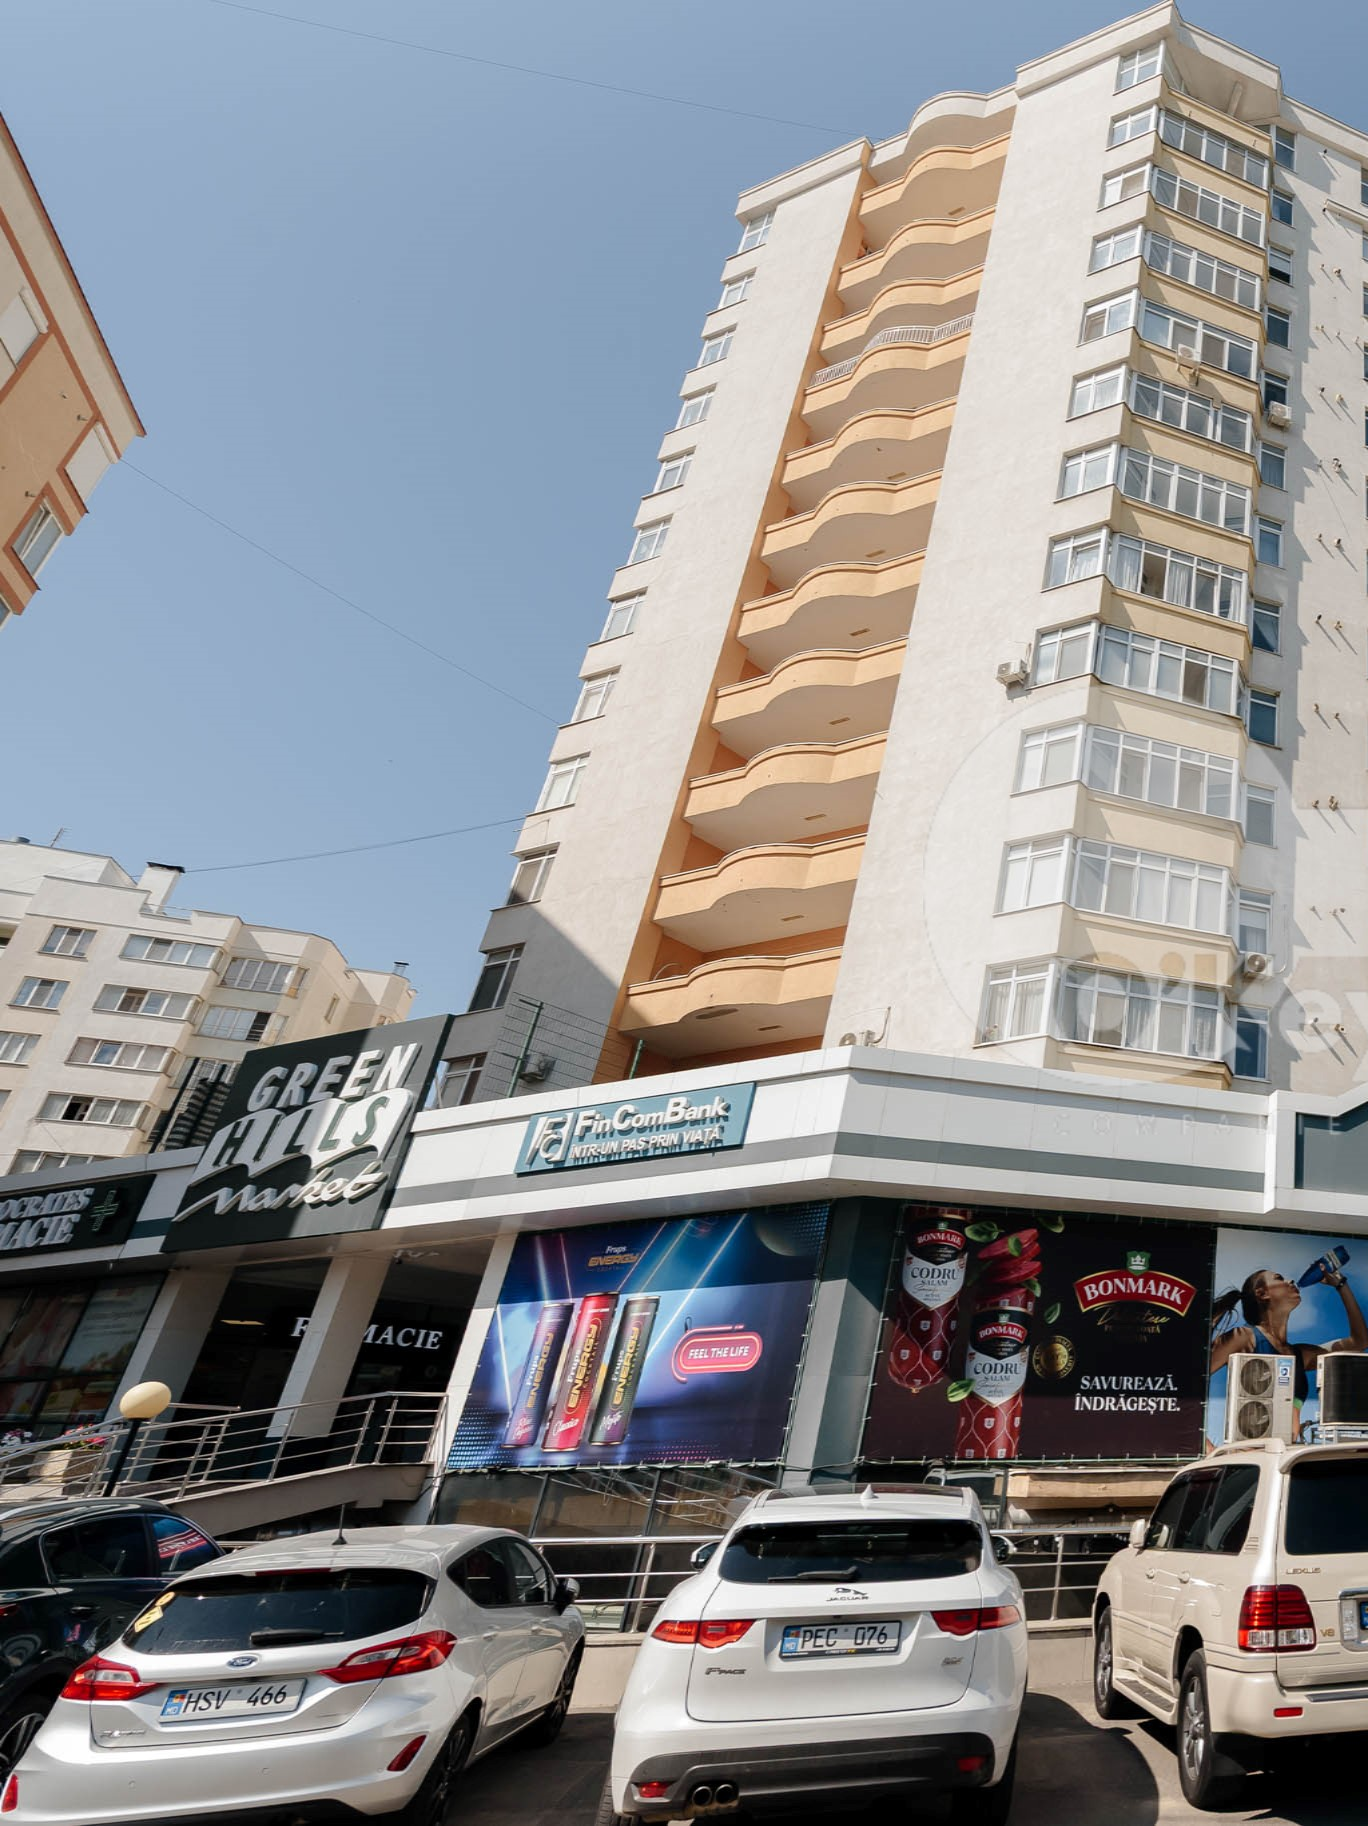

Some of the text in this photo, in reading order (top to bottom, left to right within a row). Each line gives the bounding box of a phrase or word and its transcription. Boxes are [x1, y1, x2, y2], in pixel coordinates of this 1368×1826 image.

[247, 1043, 421, 1112] GREEN
[575, 1096, 730, 1137] FinComBank
[212, 1096, 391, 1167] HILLS
[621, 1137, 646, 1152] PAS
[649, 1131, 680, 1149] PRIN
[1083, 1277, 1187, 1305] BONMARK
[567, 1323, 598, 1408] ENERGY
[613, 1326, 641, 1405] ENERGY
[688, 1345, 750, 1359] FEEL THE LIFE
[1080, 1374, 1178, 1391] SAVUREAZĂ.
[1074, 1393, 1181, 1415] ÎNDRĂGEȘTE.
[1286, 1567, 1321, 1575] LEXUS
[801, 1626, 888, 1649] PEC 076
[183, 1685, 288, 1713] HSV 466
